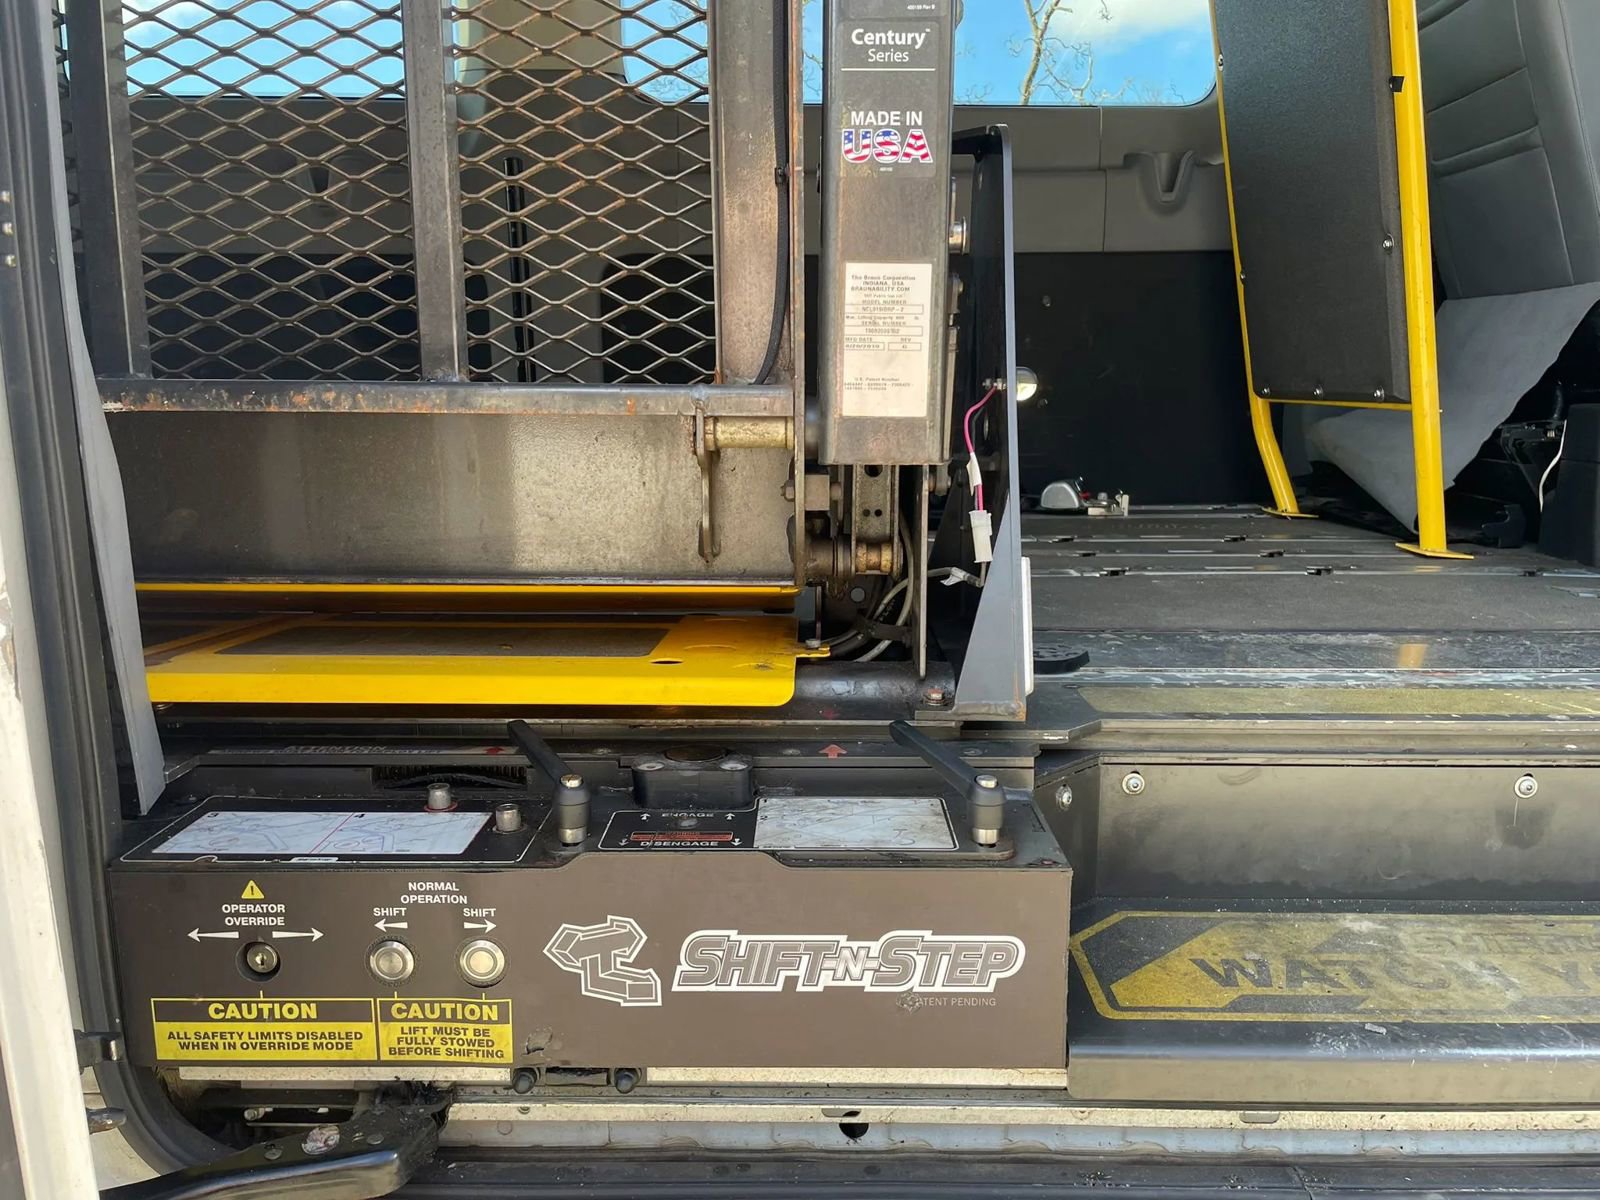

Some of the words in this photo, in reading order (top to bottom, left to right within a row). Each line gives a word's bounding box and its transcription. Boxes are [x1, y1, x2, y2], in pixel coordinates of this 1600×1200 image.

[868, 49, 909, 62] Series
[850, 111, 900, 126] MADE
[906, 111, 922, 126] IN
[842, 129, 933, 163] USA
[408, 882, 460, 891] NORMAL
[400, 895, 468, 904] OPERATION
[221, 904, 286, 913] OPERATOR
[373, 907, 407, 916] SHIFT
[463, 908, 497, 917] SHIFT
[224, 917, 285, 926] OVERRIDE
[1530, 961, 1600, 991] Y
[909, 997, 948, 1007] ATENT
[951, 997, 996, 1007] PENDING
[208, 1002, 318, 1020] CAUTION
[391, 1002, 498, 1021] CAUTION
[167, 1031, 191, 1040] ALL
[194, 1031, 245, 1040] SAFETY
[248, 1031, 293, 1040] LIMITS
[296, 1031, 364, 1041] DISABLED
[400, 1026, 428, 1035] LIFT
[432, 1027, 469, 1036] MUST
[473, 1028, 490, 1037] BE
[179, 1041, 219, 1050] WHEN
[223, 1041, 238, 1050] IN
[240, 1041, 310, 1051] OVERRIDE
[312, 1041, 354, 1051] MODE
[397, 1037, 436, 1045] FULLY
[440, 1037, 495, 1048] STOWED
[388, 1047, 441, 1056] BEFORE
[445, 1048, 505, 1059] SHIFTING
